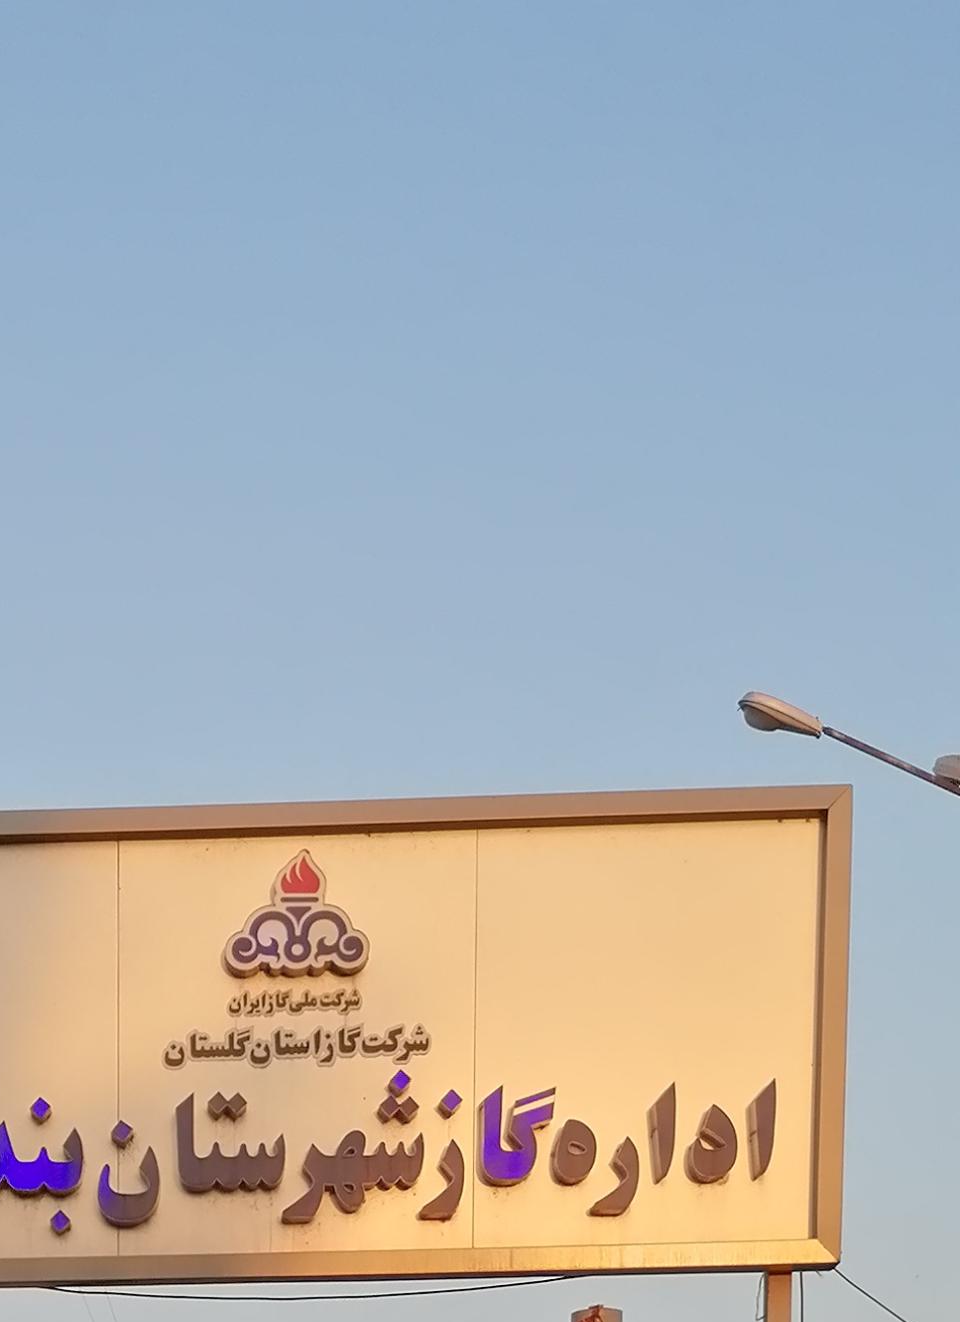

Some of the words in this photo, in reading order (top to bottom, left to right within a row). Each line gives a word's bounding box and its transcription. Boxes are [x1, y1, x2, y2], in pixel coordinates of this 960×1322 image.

[228, 993, 266, 1015] ایران
[266, 992, 291, 1014] گاز
[291, 996, 317, 1013] ملی
[319, 989, 361, 1013] شرکت
[163, 1029, 251, 1067] گلستان
[249, 1029, 321, 1065] استان
[320, 1025, 362, 1064] گاز
[361, 1024, 430, 1063] شرکت
[96, 1068, 425, 1228] شهرستان
[416, 1084, 558, 1221] گاز
[550, 1078, 777, 1218] اداره
